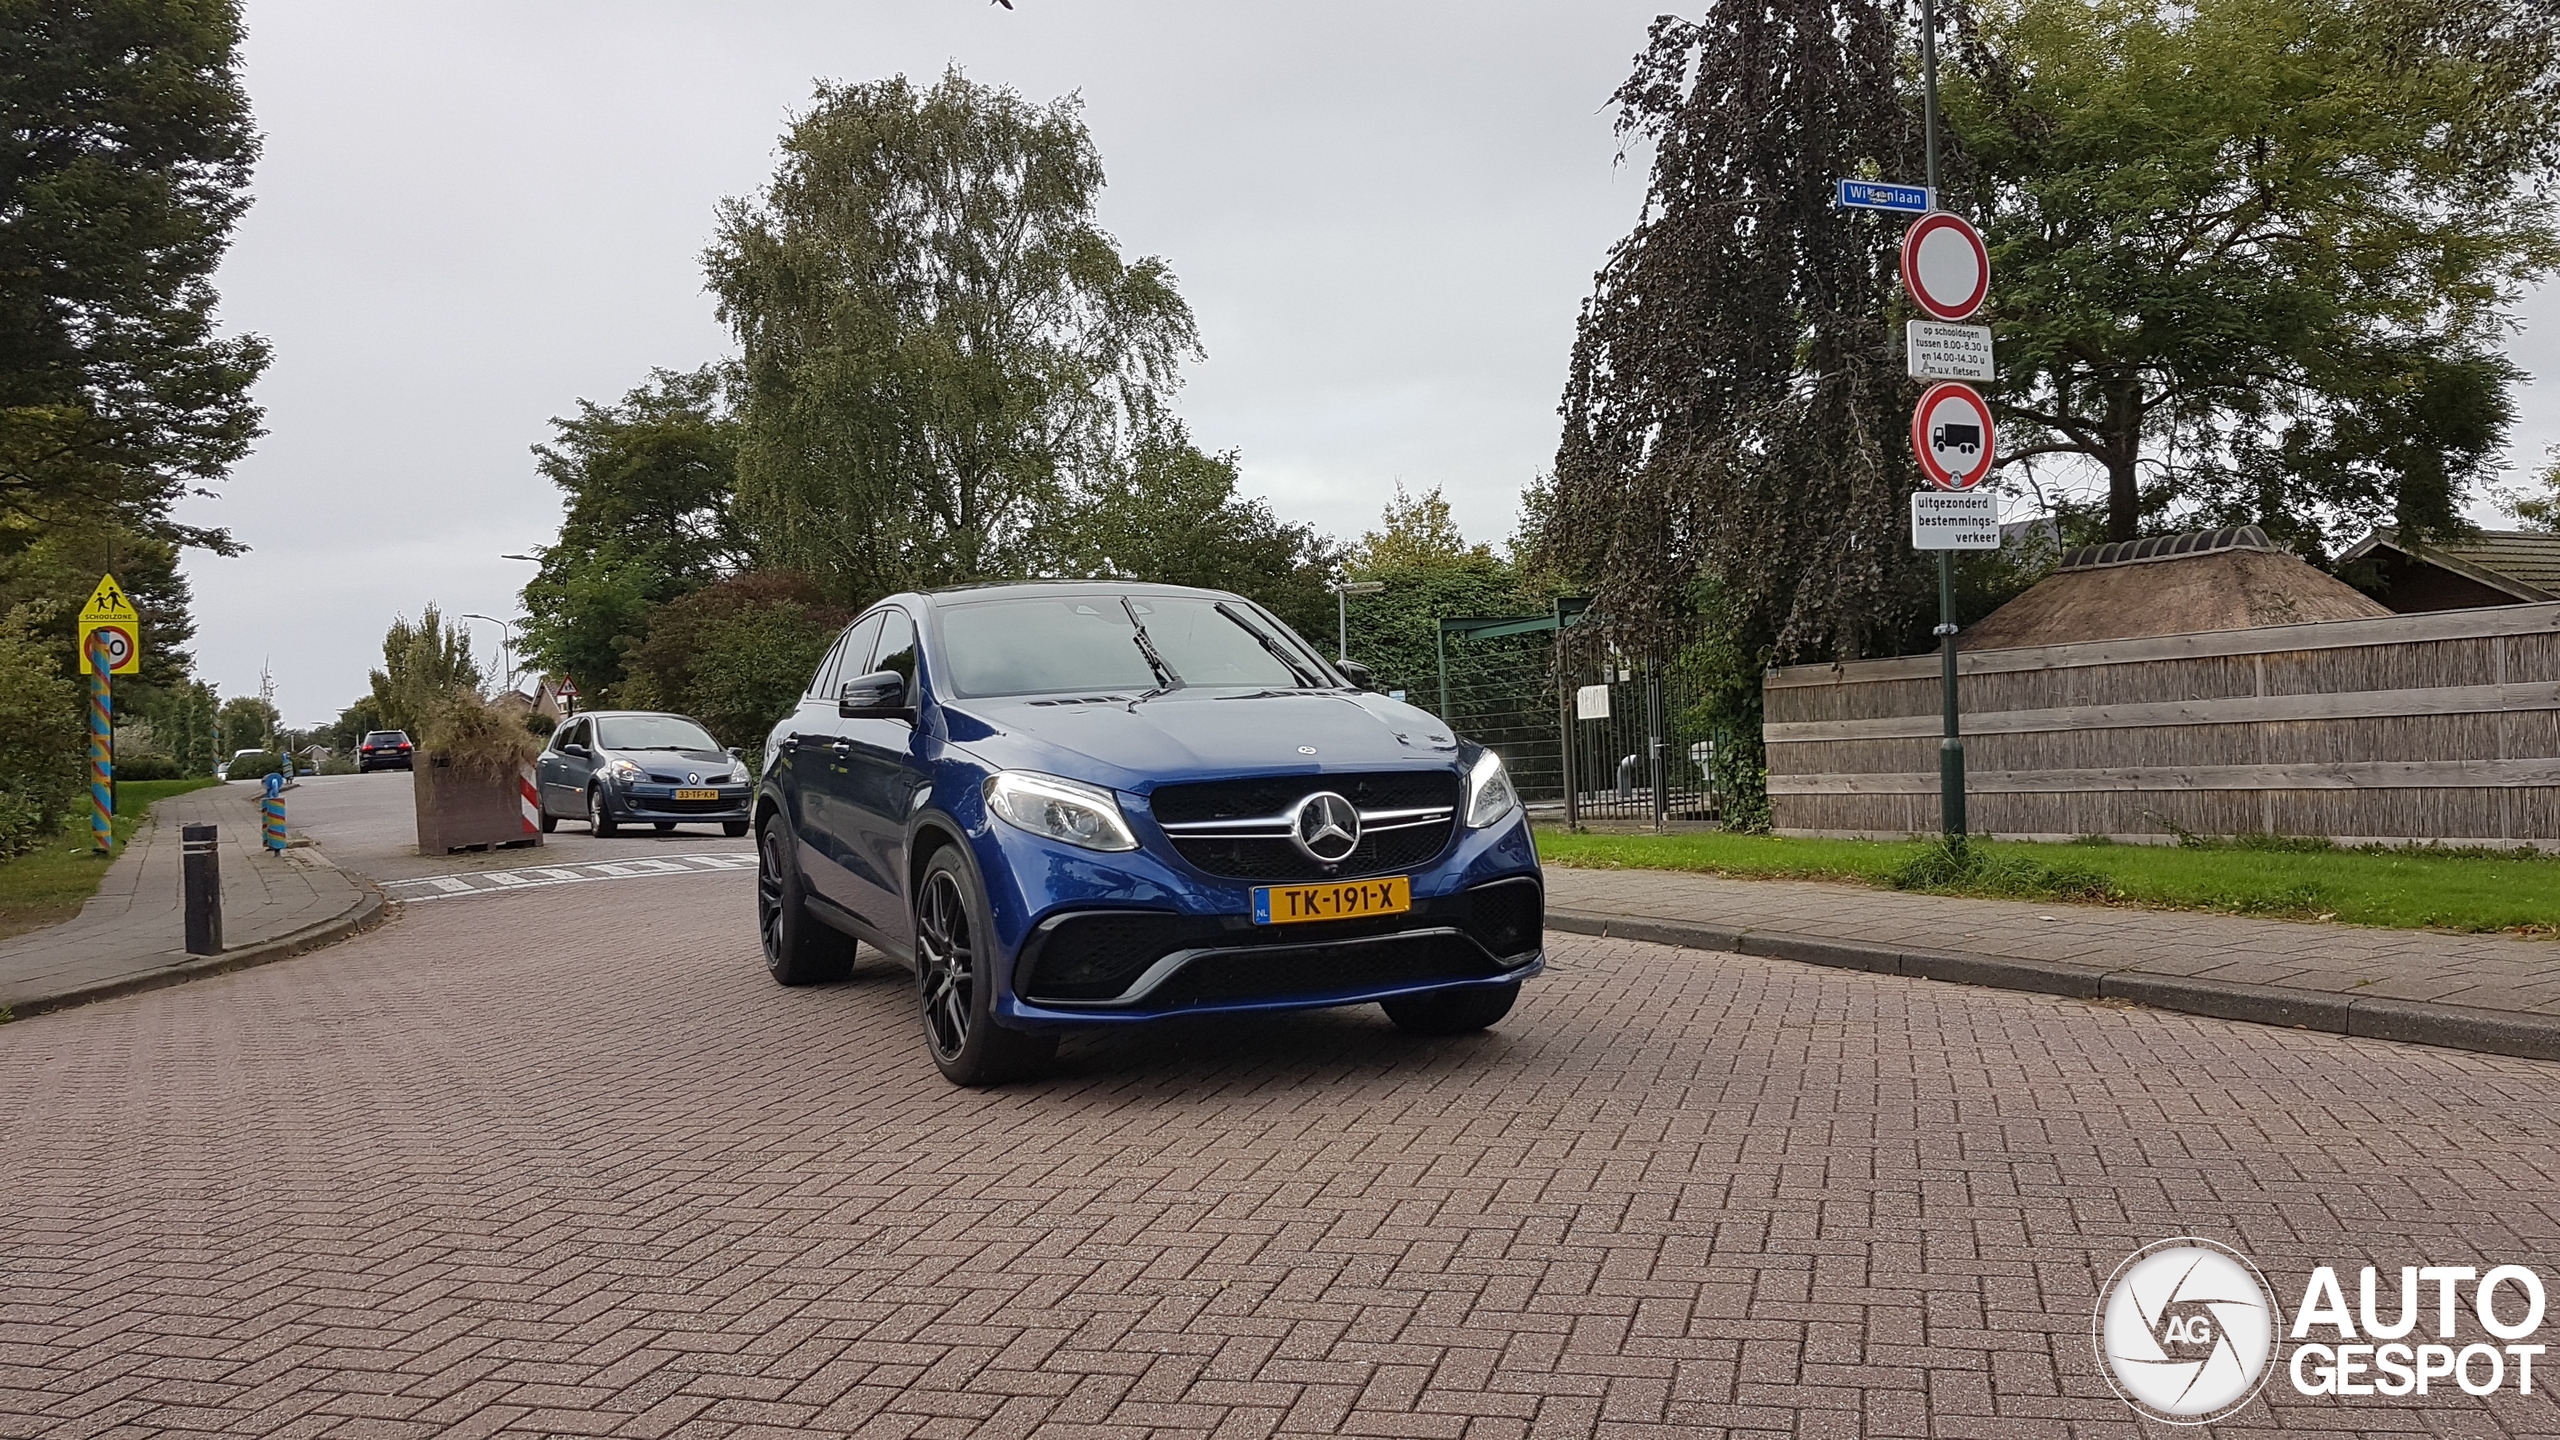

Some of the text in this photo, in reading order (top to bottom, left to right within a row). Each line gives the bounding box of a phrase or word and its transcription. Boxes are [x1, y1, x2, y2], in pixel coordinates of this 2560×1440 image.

[1850, 185, 1921, 204] Winlaan
[1923, 327, 1979, 340] op schooldagen
[1916, 338, 1941, 348] tussen
[1943, 340, 1981, 352] 8.00-8.30
[1933, 352, 1978, 363] 14.00-14.30
[1953, 366, 1981, 377] fietsers
[1918, 497, 1988, 511] uitgezonderd
[1919, 515, 1996, 529] bestemmings-
[1955, 531, 1996, 543] verkeer
[678, 790, 716, 798] 33-TF-KH
[1256, 882, 1393, 917] NL TK-191-X
